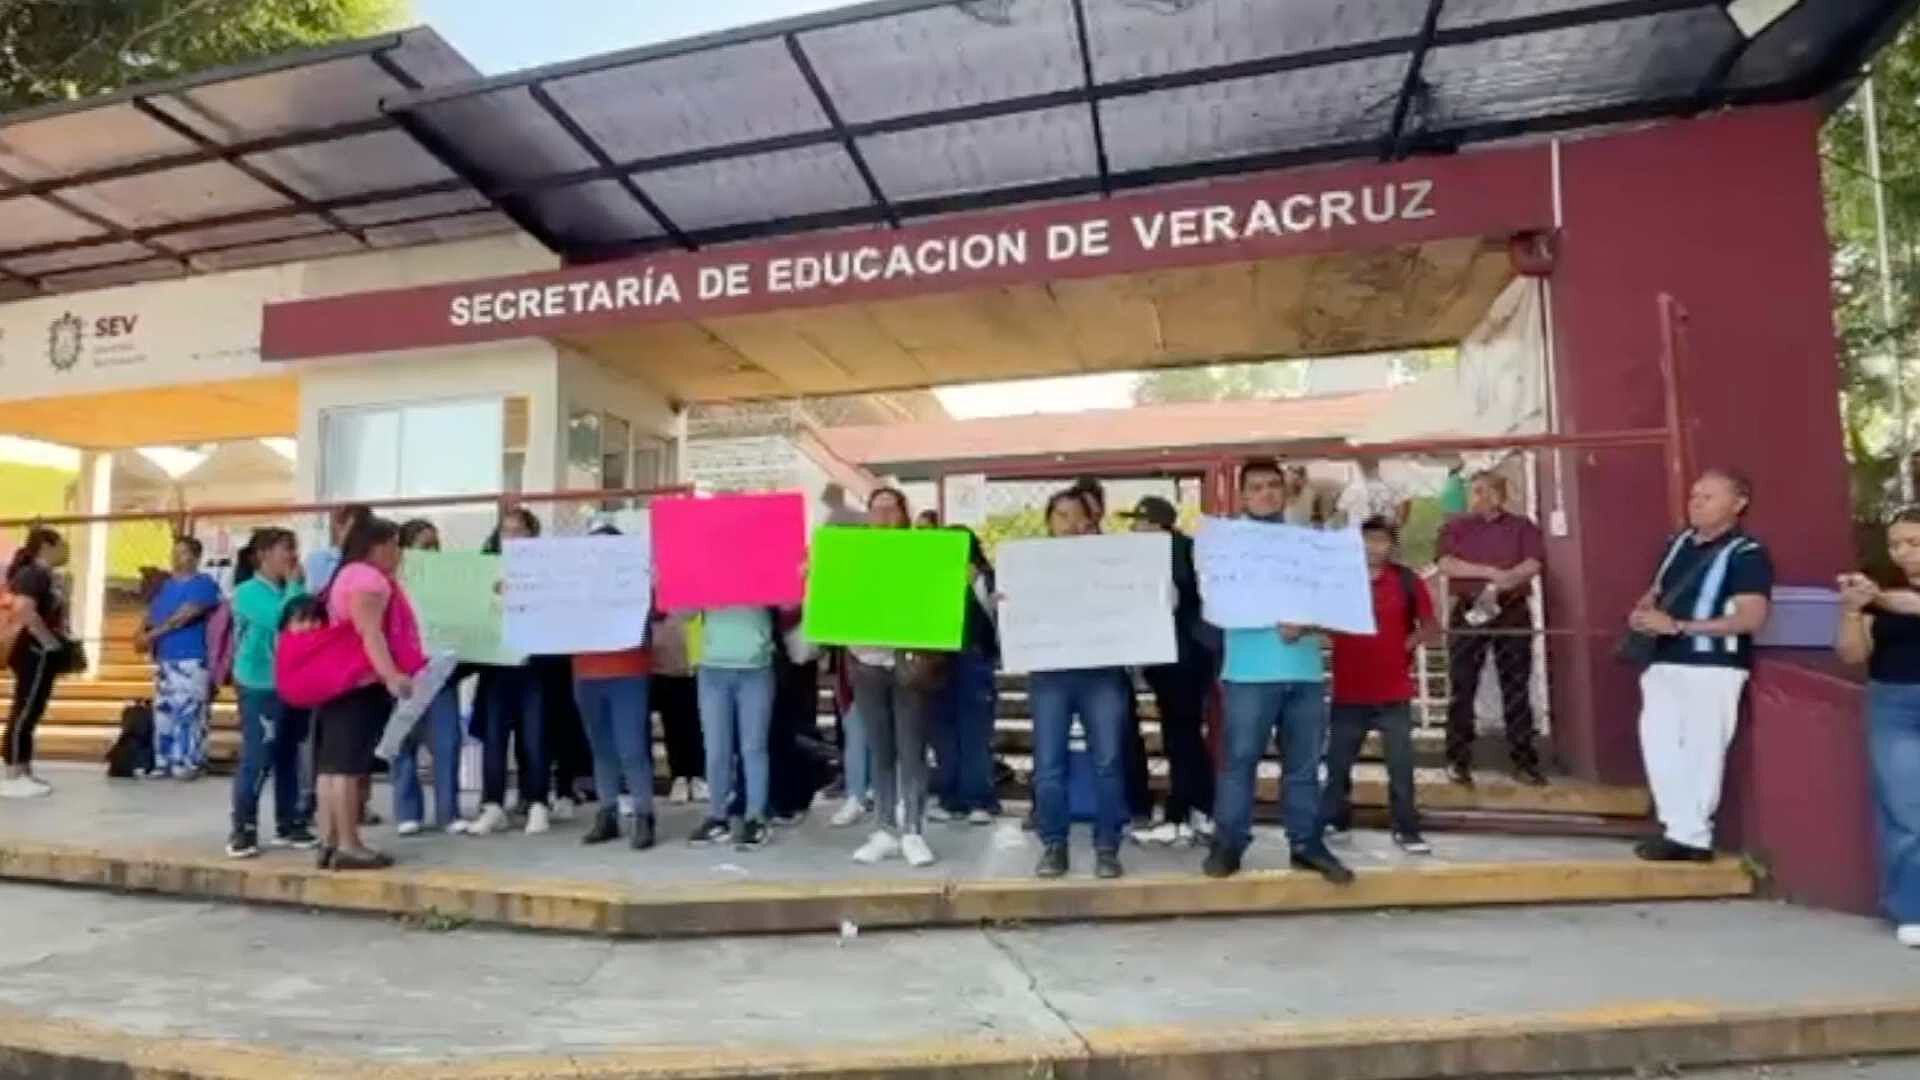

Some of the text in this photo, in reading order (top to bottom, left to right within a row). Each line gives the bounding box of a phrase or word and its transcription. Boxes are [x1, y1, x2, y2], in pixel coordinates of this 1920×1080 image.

[450, 179, 1436, 326] SECRETARÍA DE EDUCACION DE VERACRUZ
[95, 314, 139, 338] SEV
